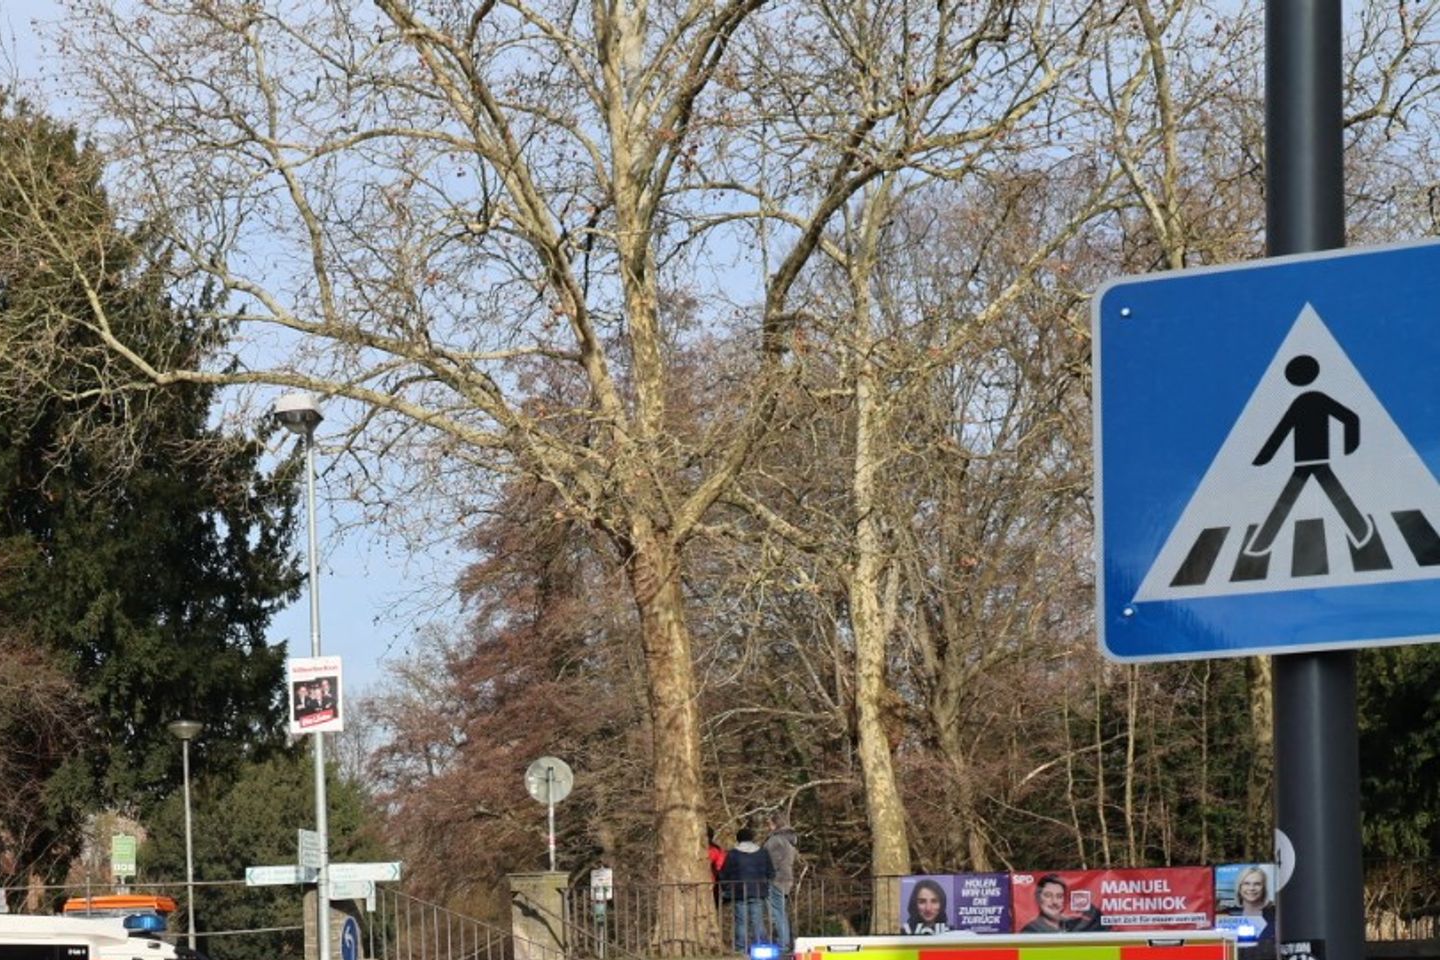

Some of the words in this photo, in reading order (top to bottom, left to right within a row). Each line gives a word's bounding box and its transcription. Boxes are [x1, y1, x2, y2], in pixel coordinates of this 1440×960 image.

[964, 879, 997, 887] HOLEN
[1013, 874, 1034, 885] SPD
[1101, 879, 1171, 894] MANUEL
[981, 888, 1001, 896] UNS
[973, 898, 990, 906] DIE
[1101, 896, 1187, 912] MICHNIOK
[958, 906, 1003, 915] ZUKUNFT
[961, 914, 1001, 925] ZURÜCK
